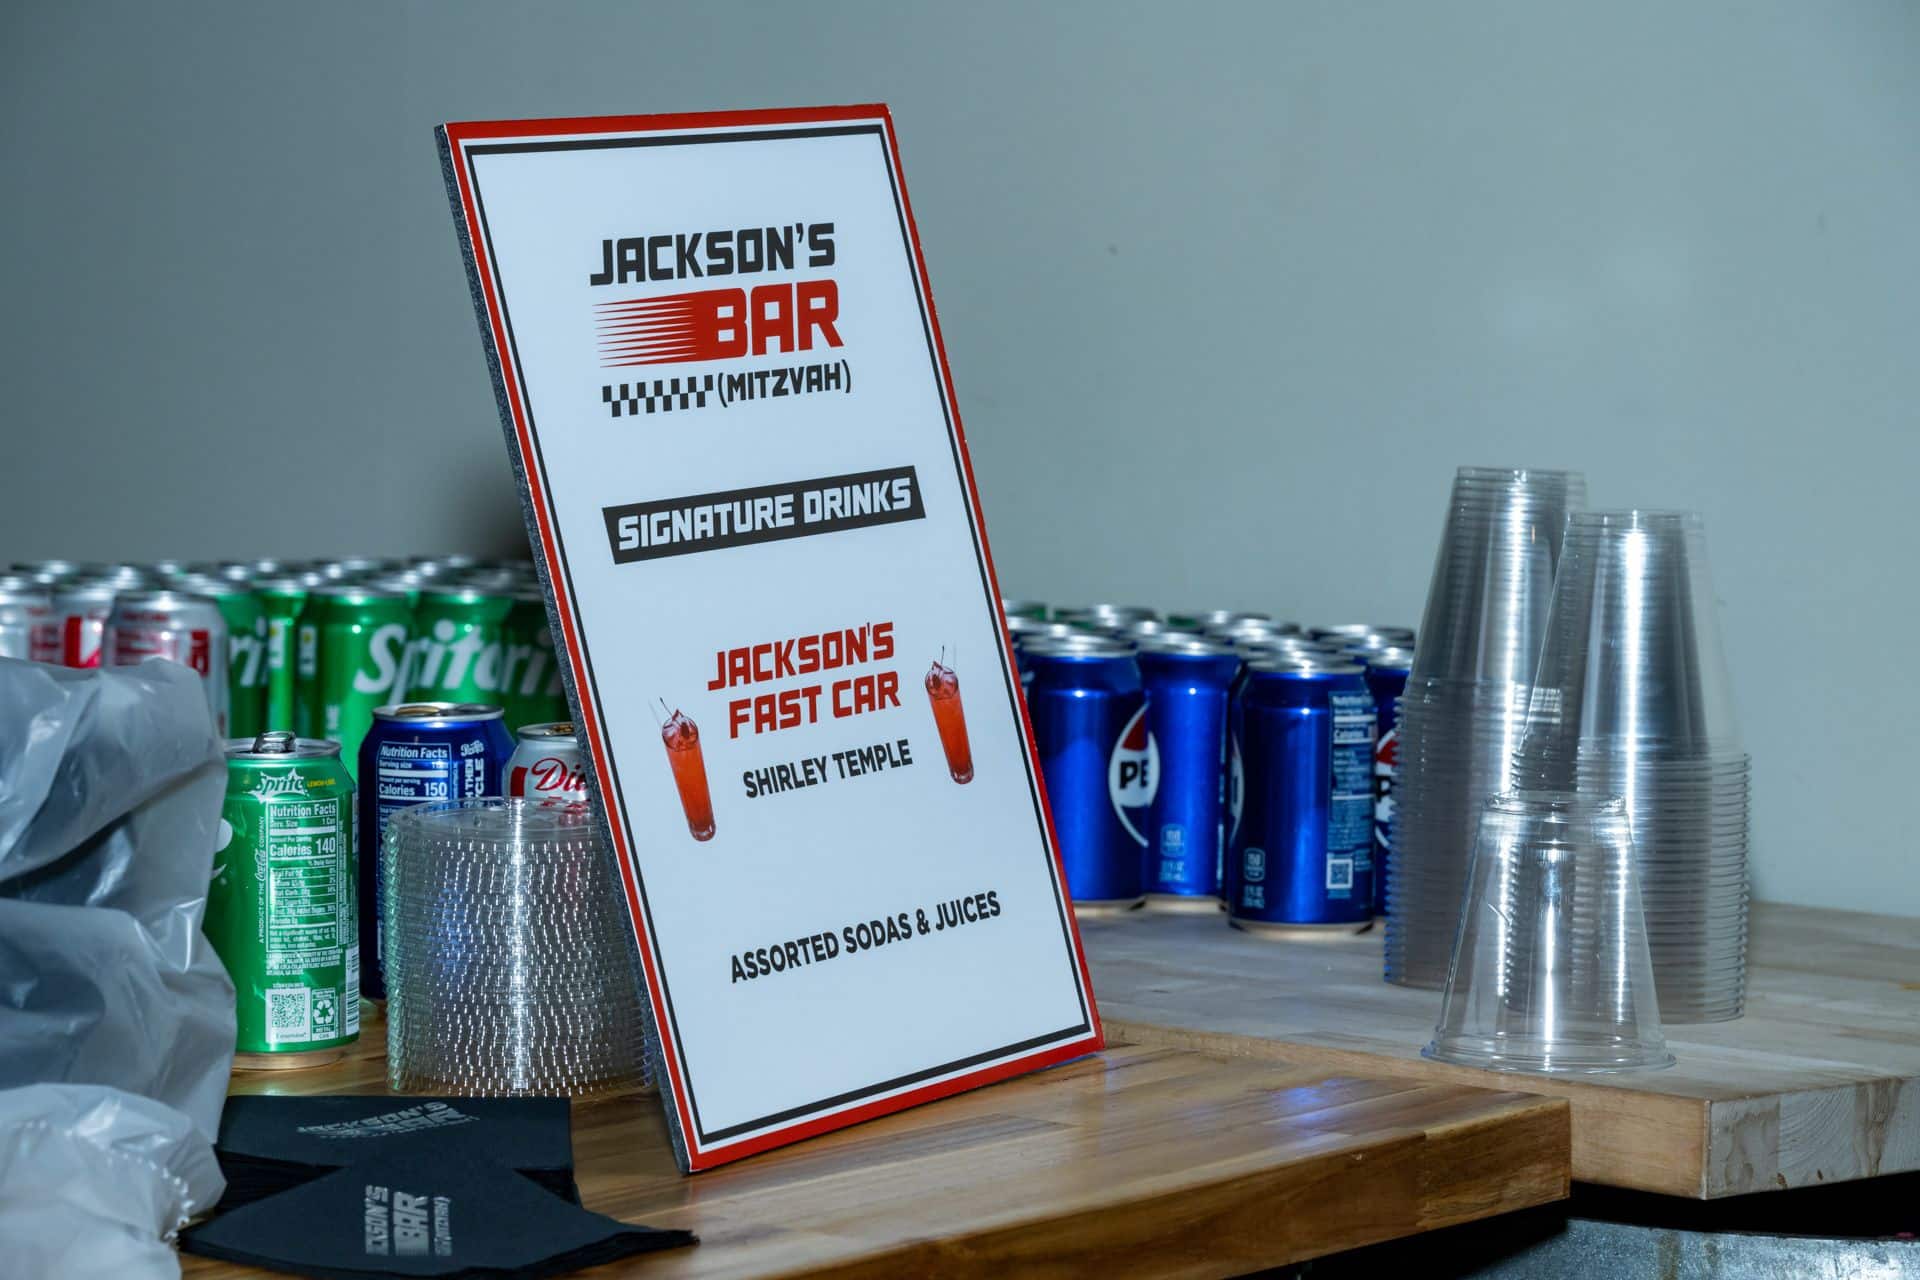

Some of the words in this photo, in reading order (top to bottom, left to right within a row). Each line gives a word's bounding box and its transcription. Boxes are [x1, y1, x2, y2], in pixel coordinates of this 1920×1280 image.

[590, 222, 836, 287] JACKSON'S
[697, 278, 845, 362] BAR
[717, 359, 851, 408] (MITZVAH)
[618, 494, 795, 551] SIGNATURE
[803, 477, 912, 524] DRINKS
[707, 621, 894, 691] JACKSON'S
[729, 685, 823, 739] FAST
[832, 671, 901, 719] CAR
[379, 745, 418, 758] Nutrition
[420, 747, 448, 758] Facts
[743, 755, 828, 798] SHIRLEY
[832, 739, 913, 780] TEMPLE
[256, 774, 303, 795] Sprite
[270, 804, 312, 817] Nutrition
[314, 803, 336, 815] Facts
[379, 783, 415, 796] Calories
[424, 782, 448, 796] 150
[270, 843, 313, 857] Calories
[315, 837, 336, 854] 140
[731, 931, 839, 983] ASSORTED
[843, 912, 912, 954] SODAS
[916, 908, 931, 935] &
[935, 890, 1001, 931] JUICES
[393, 1191, 429, 1250] BAR
